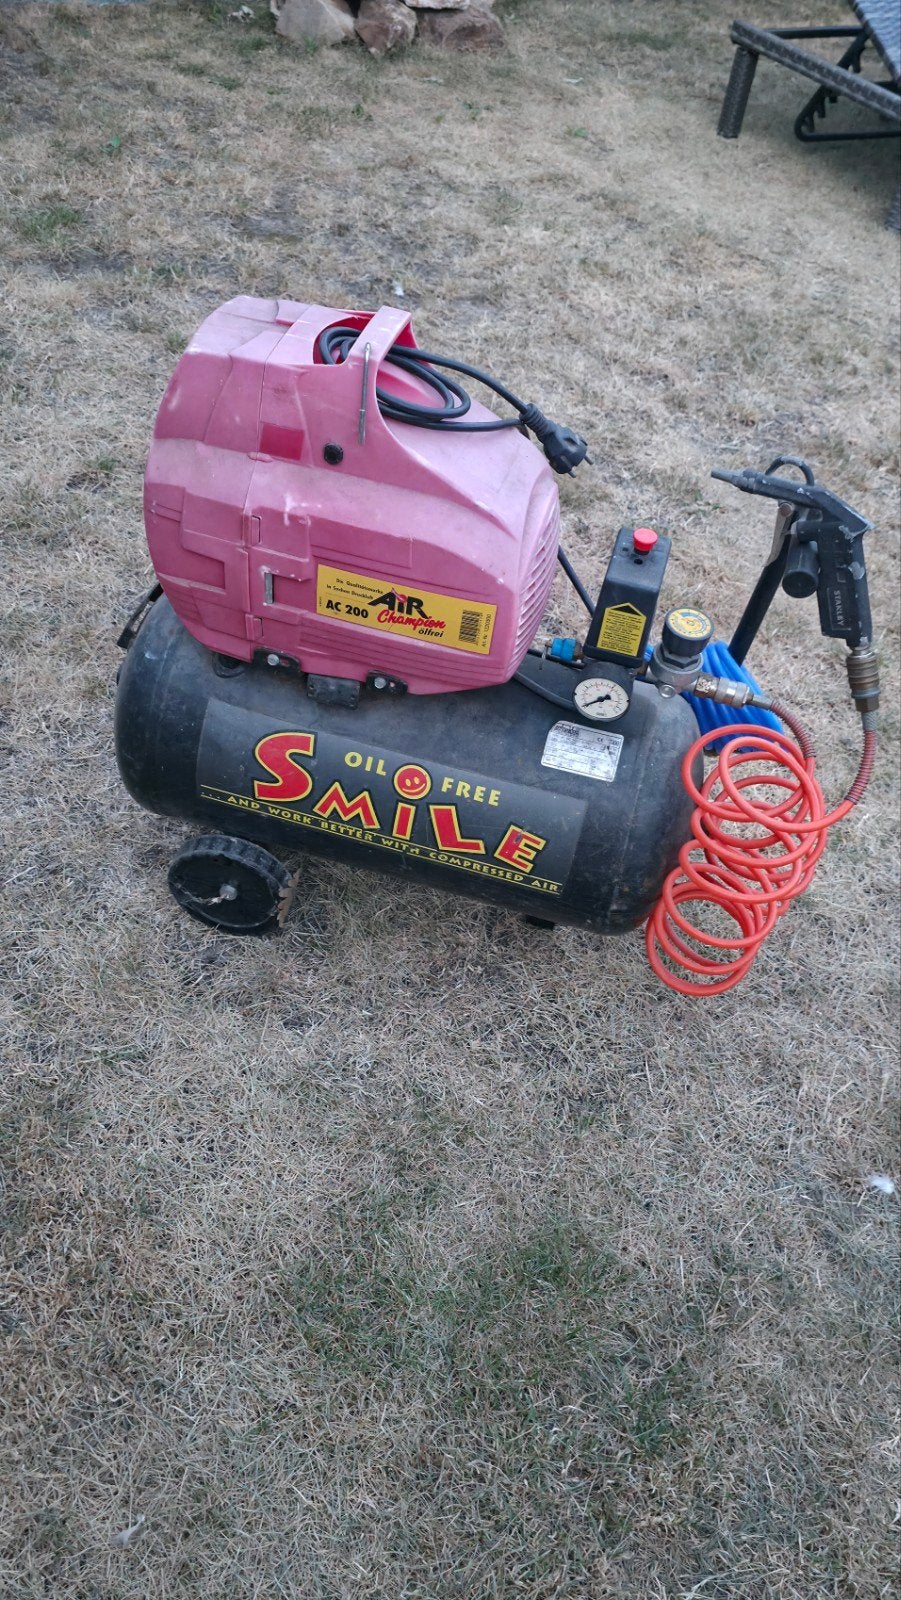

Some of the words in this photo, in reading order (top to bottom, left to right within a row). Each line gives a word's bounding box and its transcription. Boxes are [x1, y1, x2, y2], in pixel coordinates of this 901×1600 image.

[325, 599, 342, 612] AC
[345, 604, 369, 619] 200
[377, 609, 446, 630] Champion
[833, 590, 845, 626] STANLEY
[418, 627, 445, 638] ölfrei
[344, 751, 387, 776] OIL
[441, 776, 501, 807] FREE
[226, 795, 261, 810] AND
[268, 805, 312, 825] WORK
[320, 819, 373, 842] BETTER
[380, 837, 421, 855] WITH
[429, 851, 524, 882] COMPRESSED
[531, 879, 559, 892] AIR
